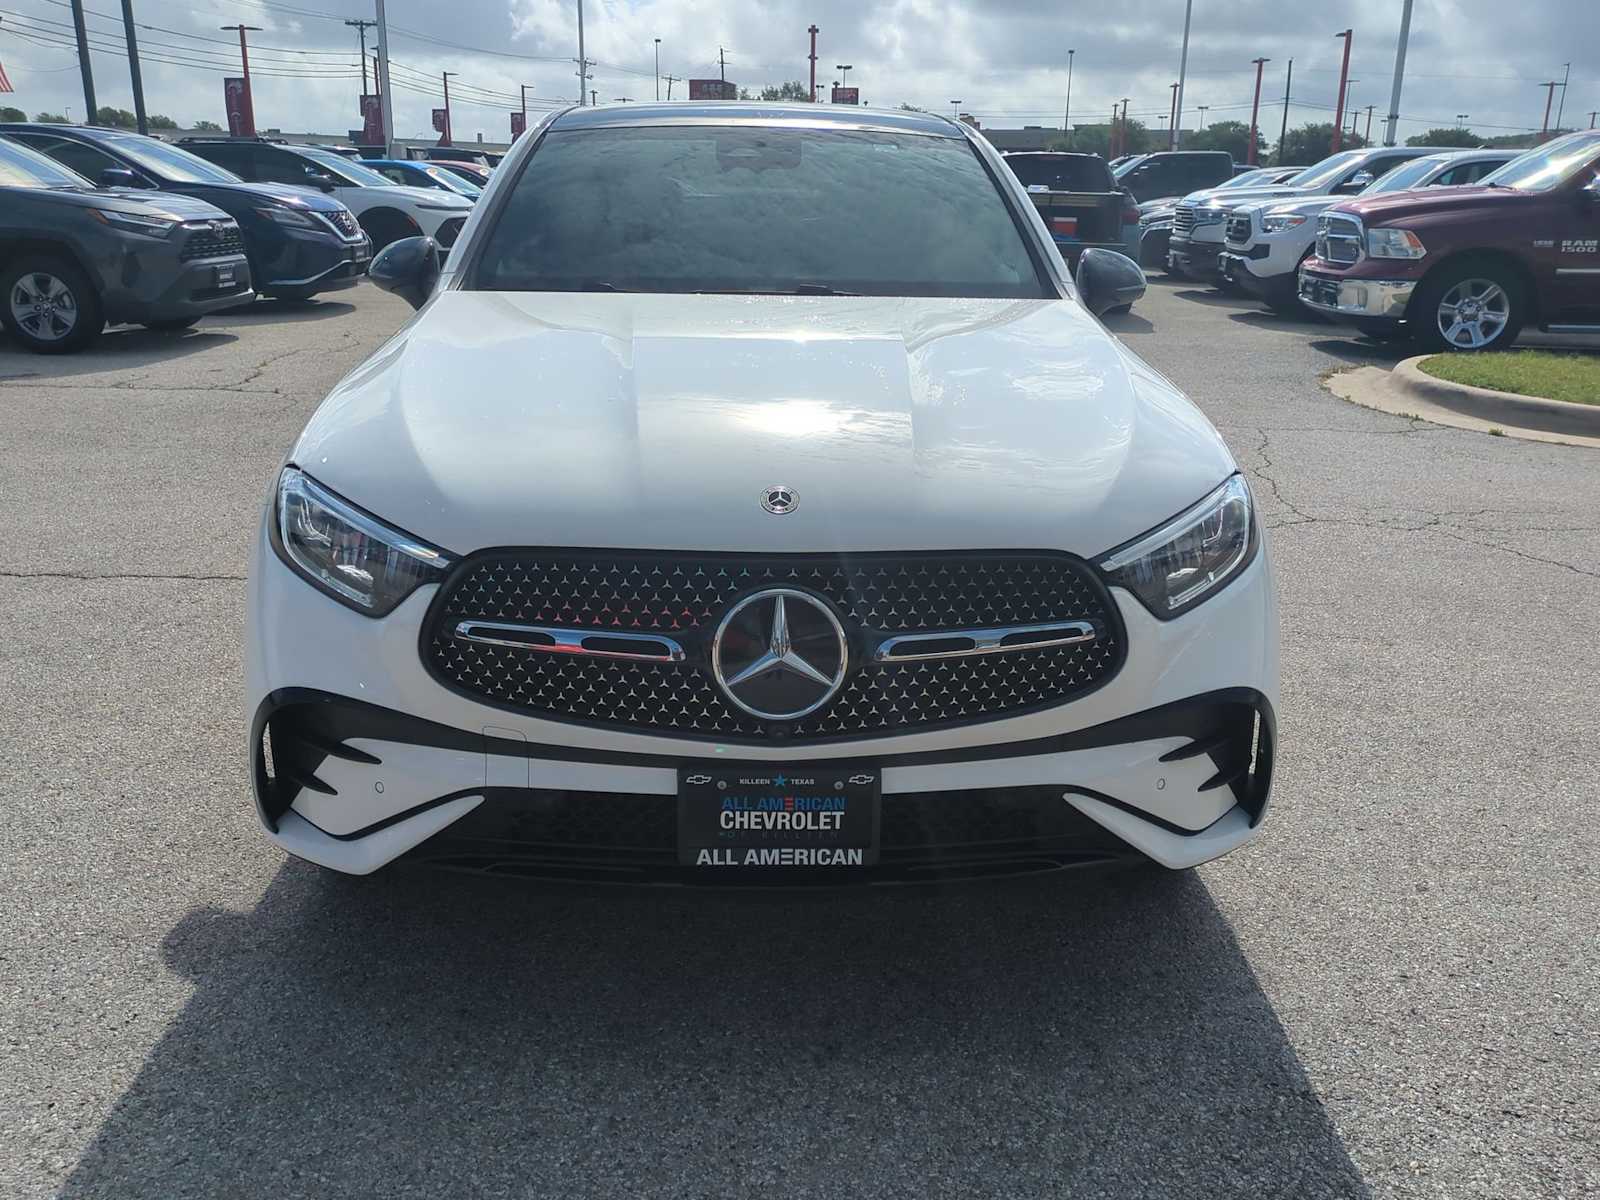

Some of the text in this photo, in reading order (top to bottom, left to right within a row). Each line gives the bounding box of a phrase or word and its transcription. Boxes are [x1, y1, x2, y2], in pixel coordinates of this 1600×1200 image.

[721, 798, 846, 811] ALL AMERICAN
[720, 811, 845, 830] CHEVROLET
[696, 849, 863, 865] ALL AMERICAN
